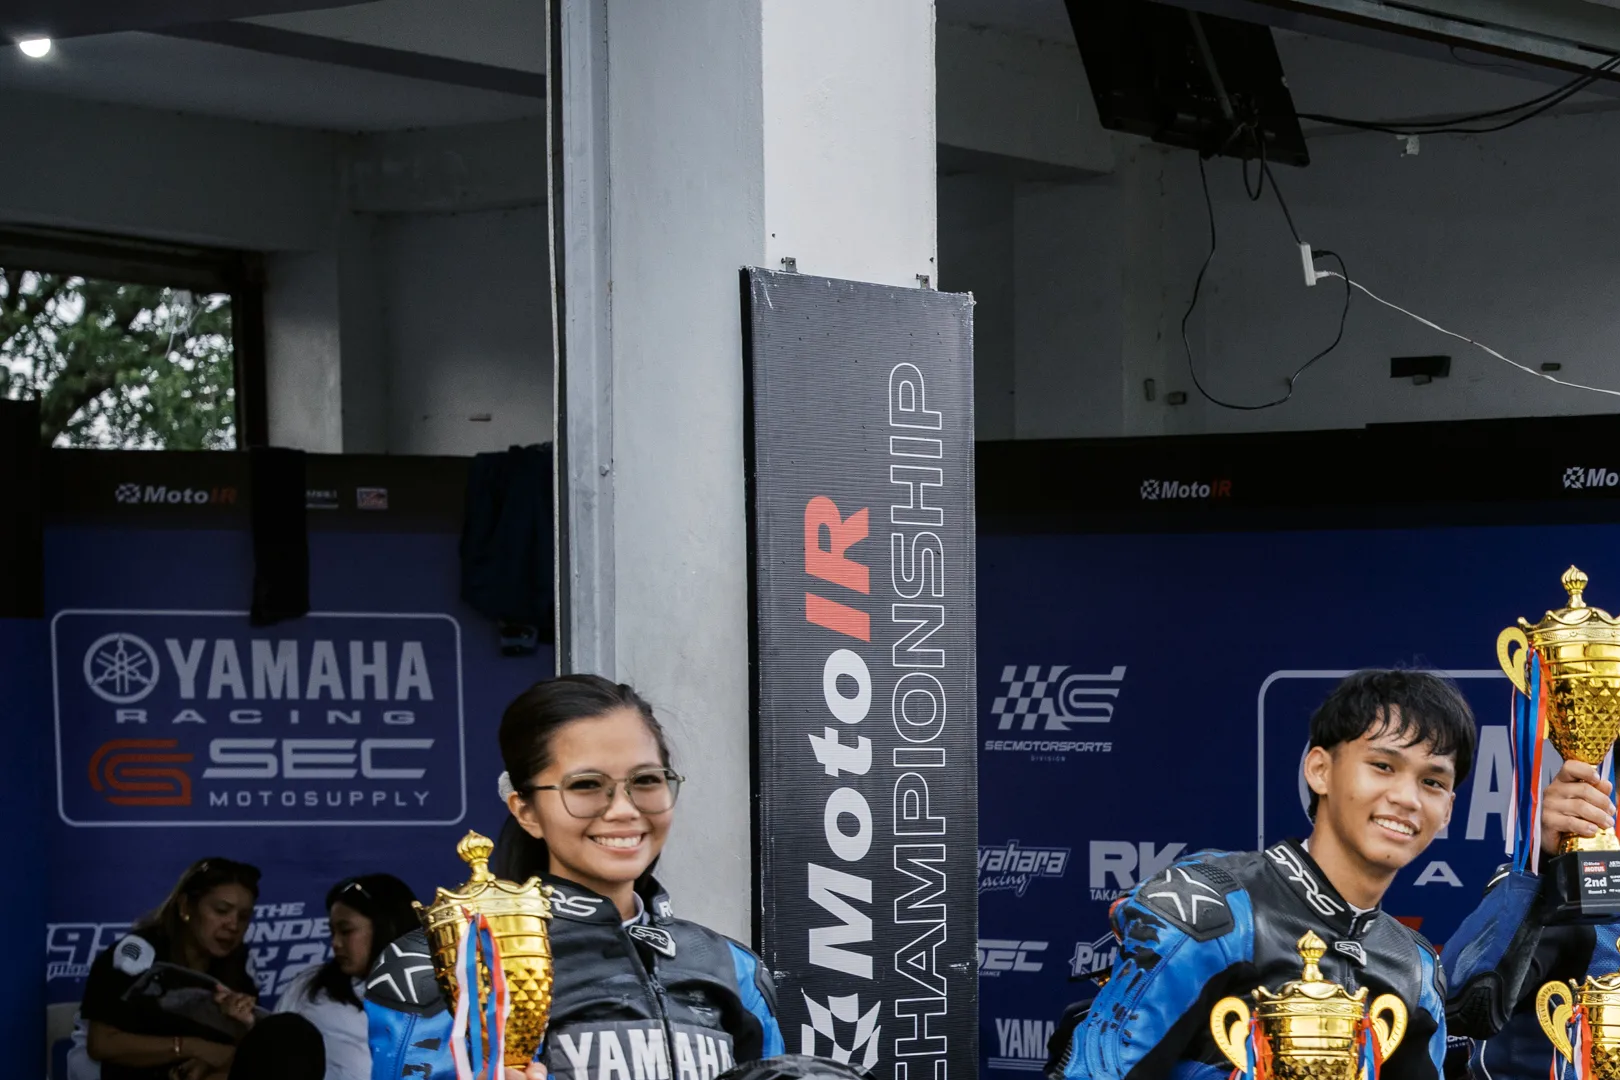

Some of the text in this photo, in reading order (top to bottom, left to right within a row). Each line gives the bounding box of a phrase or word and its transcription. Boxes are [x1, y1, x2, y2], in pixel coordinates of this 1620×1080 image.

[142, 484, 237, 505] MotoIR
[1160, 479, 1232, 500] MotoIR
[165, 638, 434, 701] YAMAHA
[115, 709, 416, 725] RACING
[804, 494, 873, 980] MotoIR
[984, 740, 1113, 754] SECMOTORSPORTS
[202, 738, 436, 779] SEC
[209, 789, 430, 807] MOTOSUPPLY
[1088, 840, 1188, 888] RK
[979, 873, 1028, 893] acing
[1584, 877, 1607, 888] 2nd
[253, 902, 305, 919] THE
